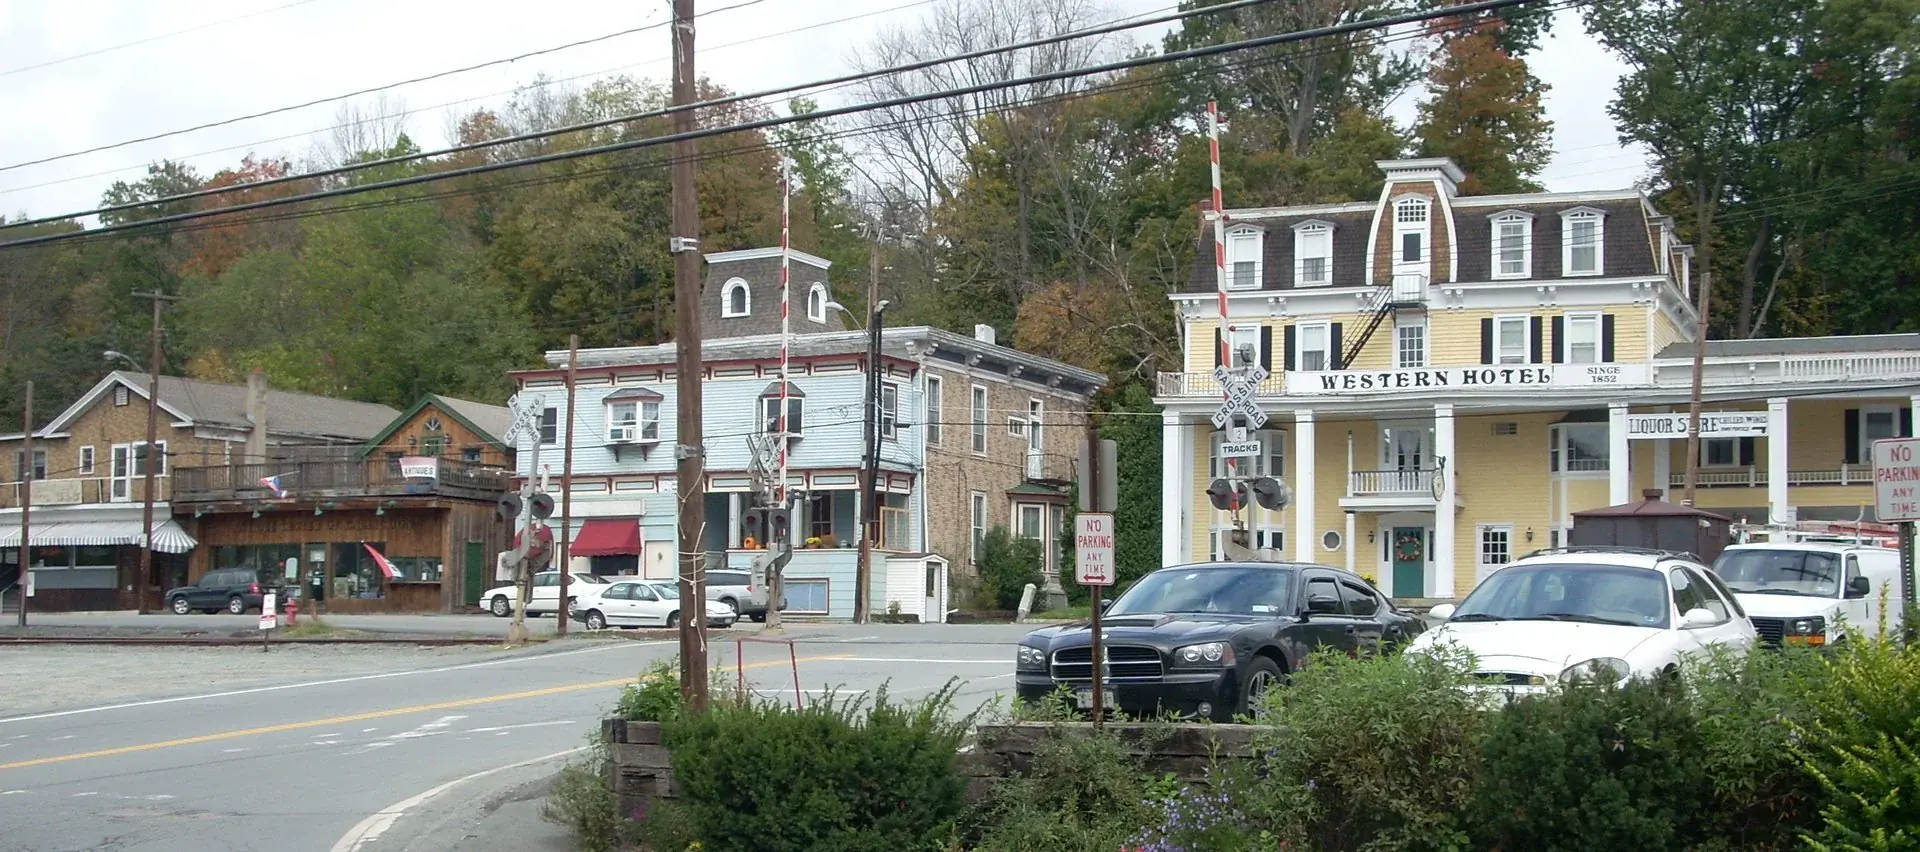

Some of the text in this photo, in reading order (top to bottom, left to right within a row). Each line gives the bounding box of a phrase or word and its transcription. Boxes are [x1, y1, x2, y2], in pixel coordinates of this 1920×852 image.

[1320, 368, 1551, 390] WESTERN HOTEL
[1591, 375, 1617, 383] 1852
[1214, 368, 1266, 427] RAIL ROAD
[1215, 370, 1264, 423] CROSSING
[506, 398, 540, 441] CROSSING
[1628, 417, 1719, 434] LIQUOR SRE
[1222, 444, 1258, 453] TRACKS
[1890, 446, 1912, 462] NO
[1878, 466, 1920, 482] PARKIN
[1892, 487, 1914, 498] ANY
[1890, 502, 1918, 513] TIME
[1086, 519, 1102, 532] NO
[1078, 535, 1112, 549] PARKING
[1086, 552, 1103, 561] ANY
[1085, 564, 1105, 574] TIME
